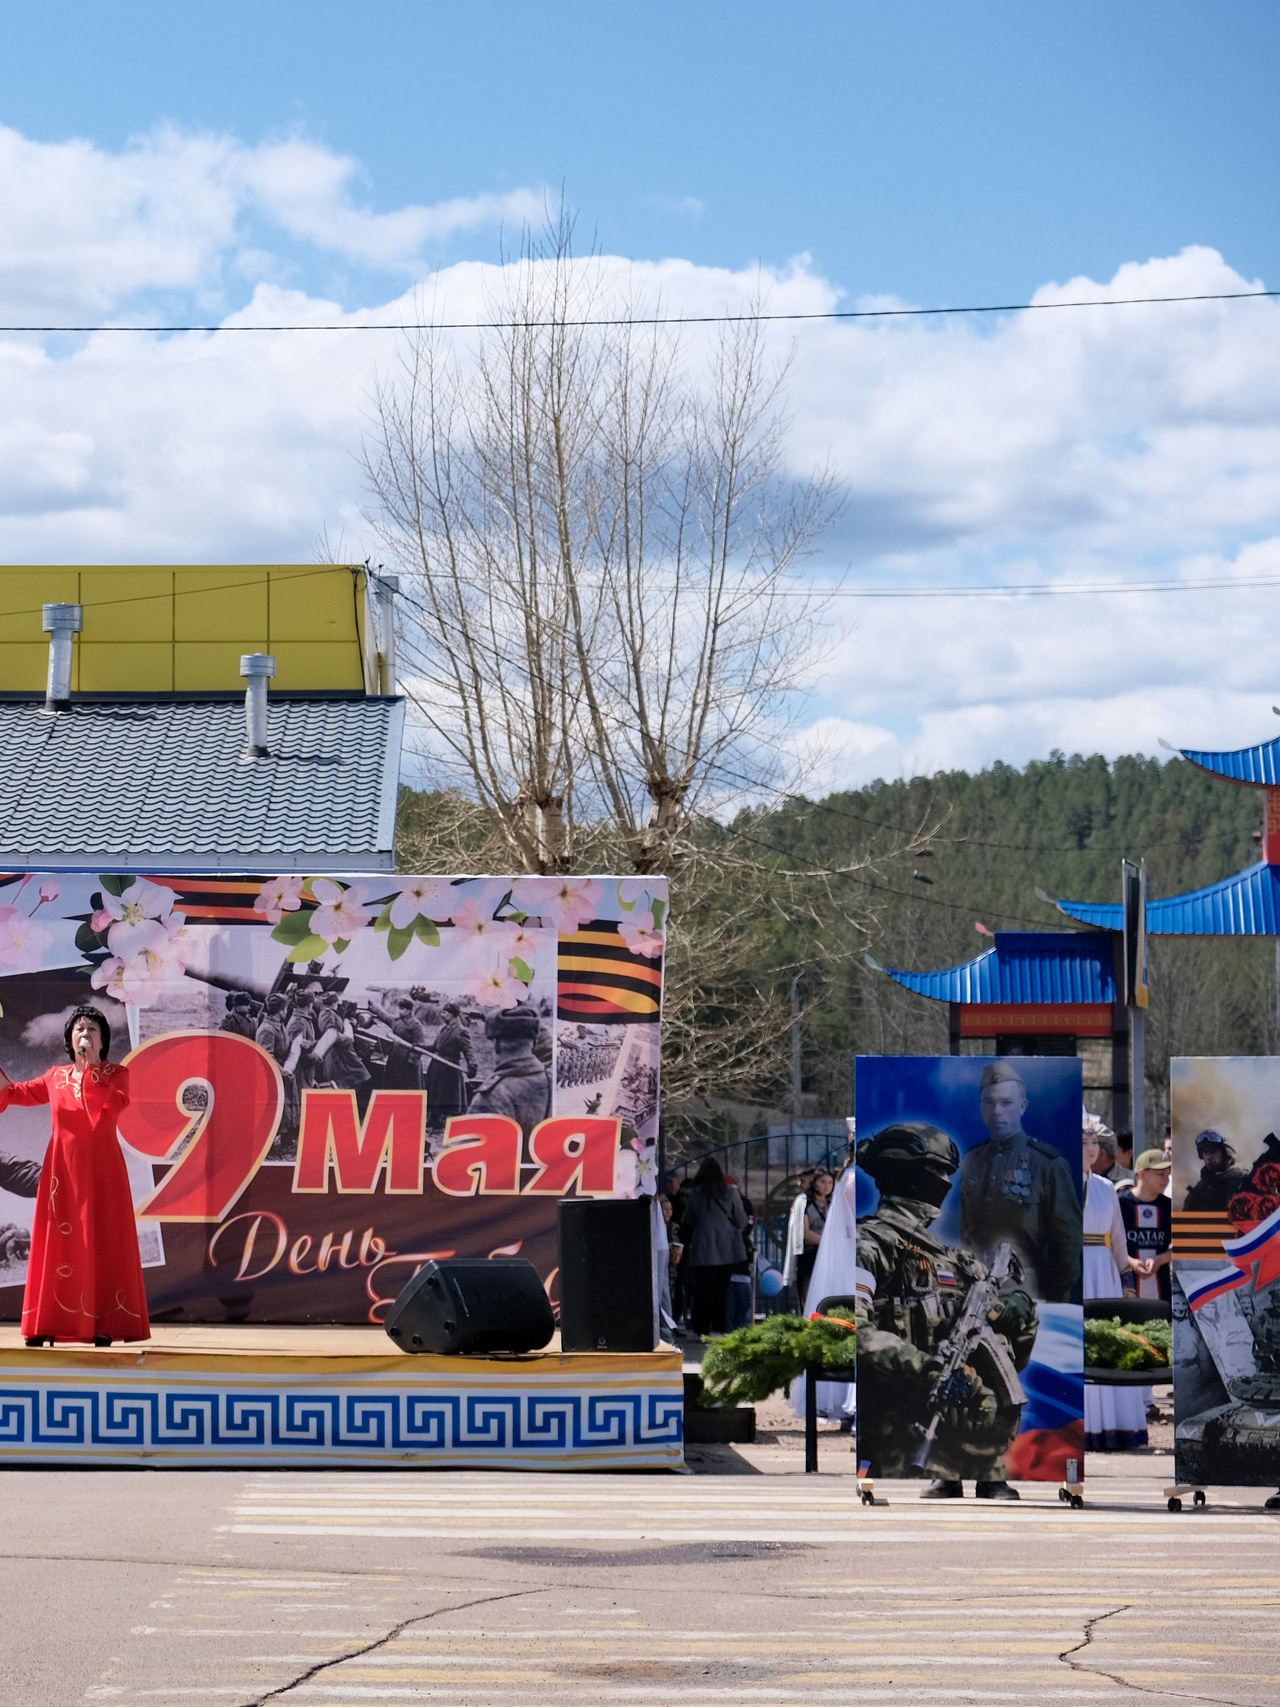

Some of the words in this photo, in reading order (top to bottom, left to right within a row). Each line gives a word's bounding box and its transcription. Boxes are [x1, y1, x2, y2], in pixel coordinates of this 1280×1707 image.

[117, 1030, 284, 1223] 9
[291, 1088, 622, 1197] Мая
[209, 1210, 397, 1282] День
[1127, 1230, 1165, 1242] QATAR
